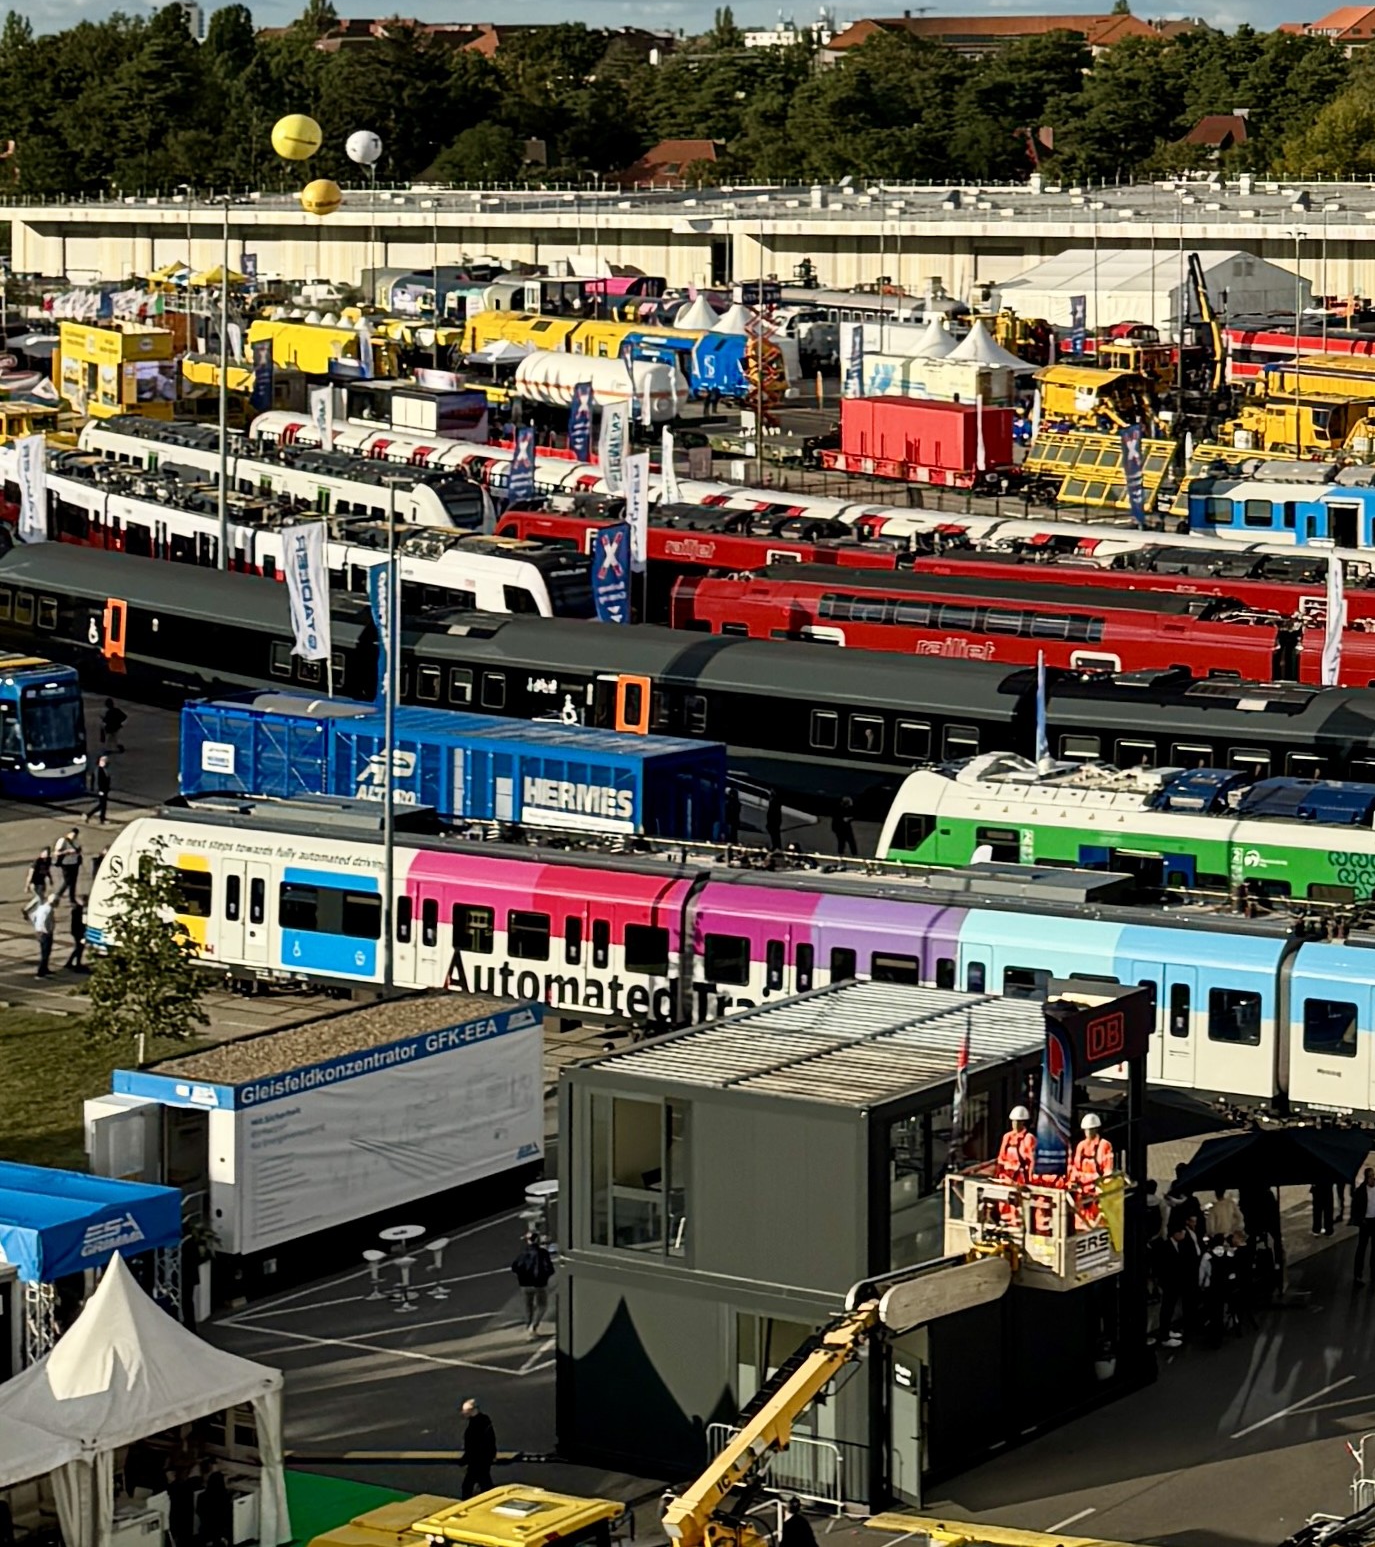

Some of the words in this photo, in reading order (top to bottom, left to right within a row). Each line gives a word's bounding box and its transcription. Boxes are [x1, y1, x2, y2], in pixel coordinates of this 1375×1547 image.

[523, 776, 633, 818] HERMES
[168, 833, 184, 847] The
[186, 837, 207, 849] next
[208, 840, 234, 853] steps
[235, 843, 275, 856] towards
[276, 847, 298, 861] fully
[298, 850, 352, 866] automated
[444, 949, 678, 1024] Automated
[240, 1043, 418, 1104] Gleisfeldkonzentrator
[425, 1019, 498, 1052] GFK-EEA
[1076, 1230, 1109, 1253] SRS
